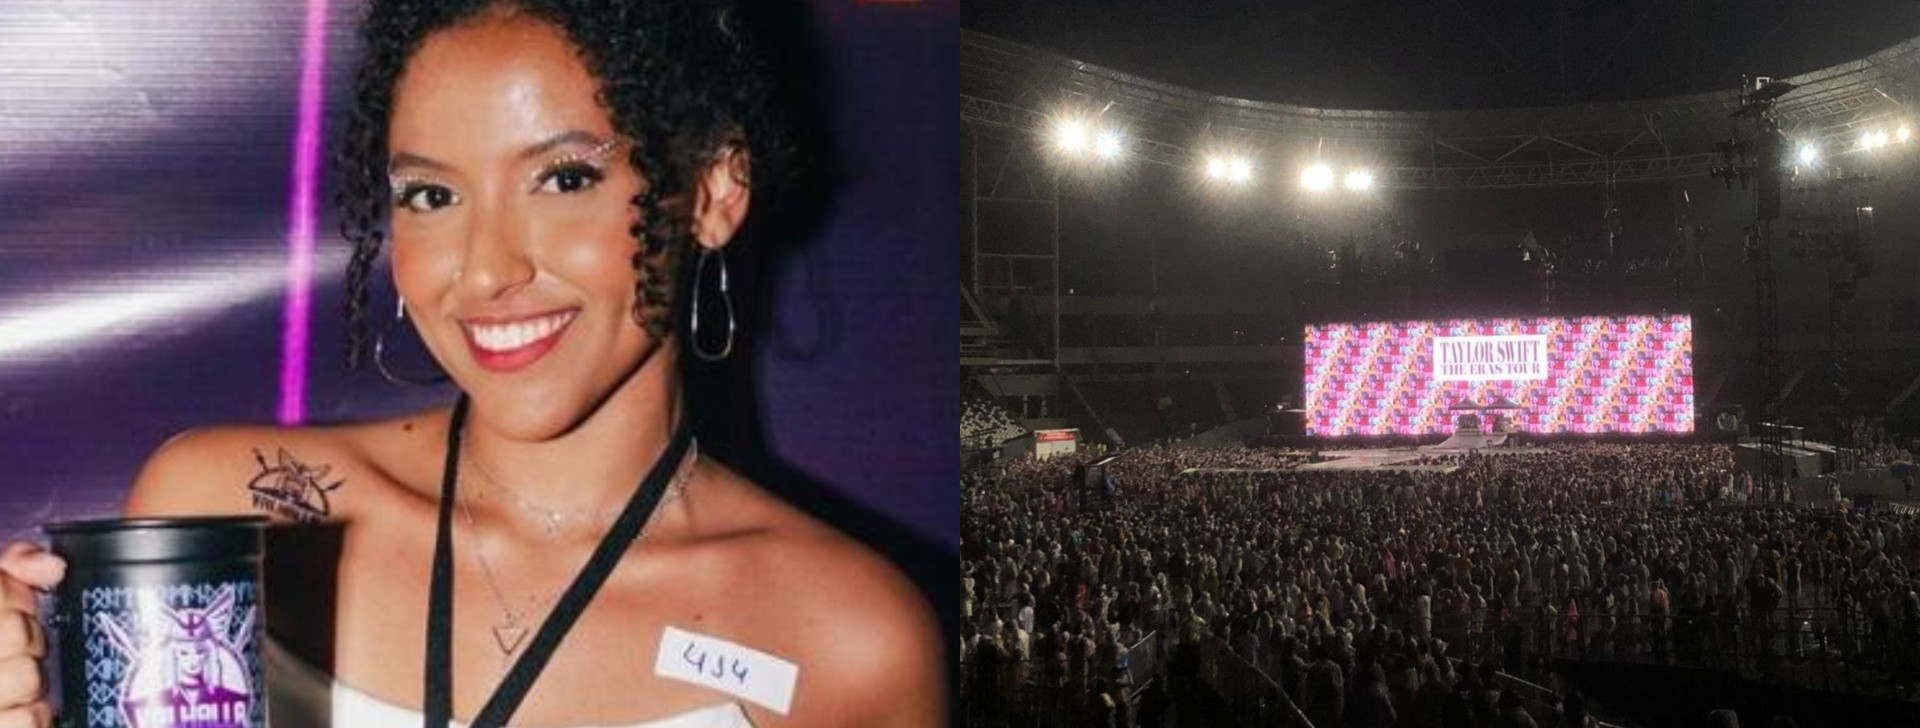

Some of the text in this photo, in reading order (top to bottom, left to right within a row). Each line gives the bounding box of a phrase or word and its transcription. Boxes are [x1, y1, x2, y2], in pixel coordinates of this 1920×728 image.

[1440, 340, 1541, 364] TAYLOR SWIFT
[1441, 362, 1540, 375] THE ERAS TOUR
